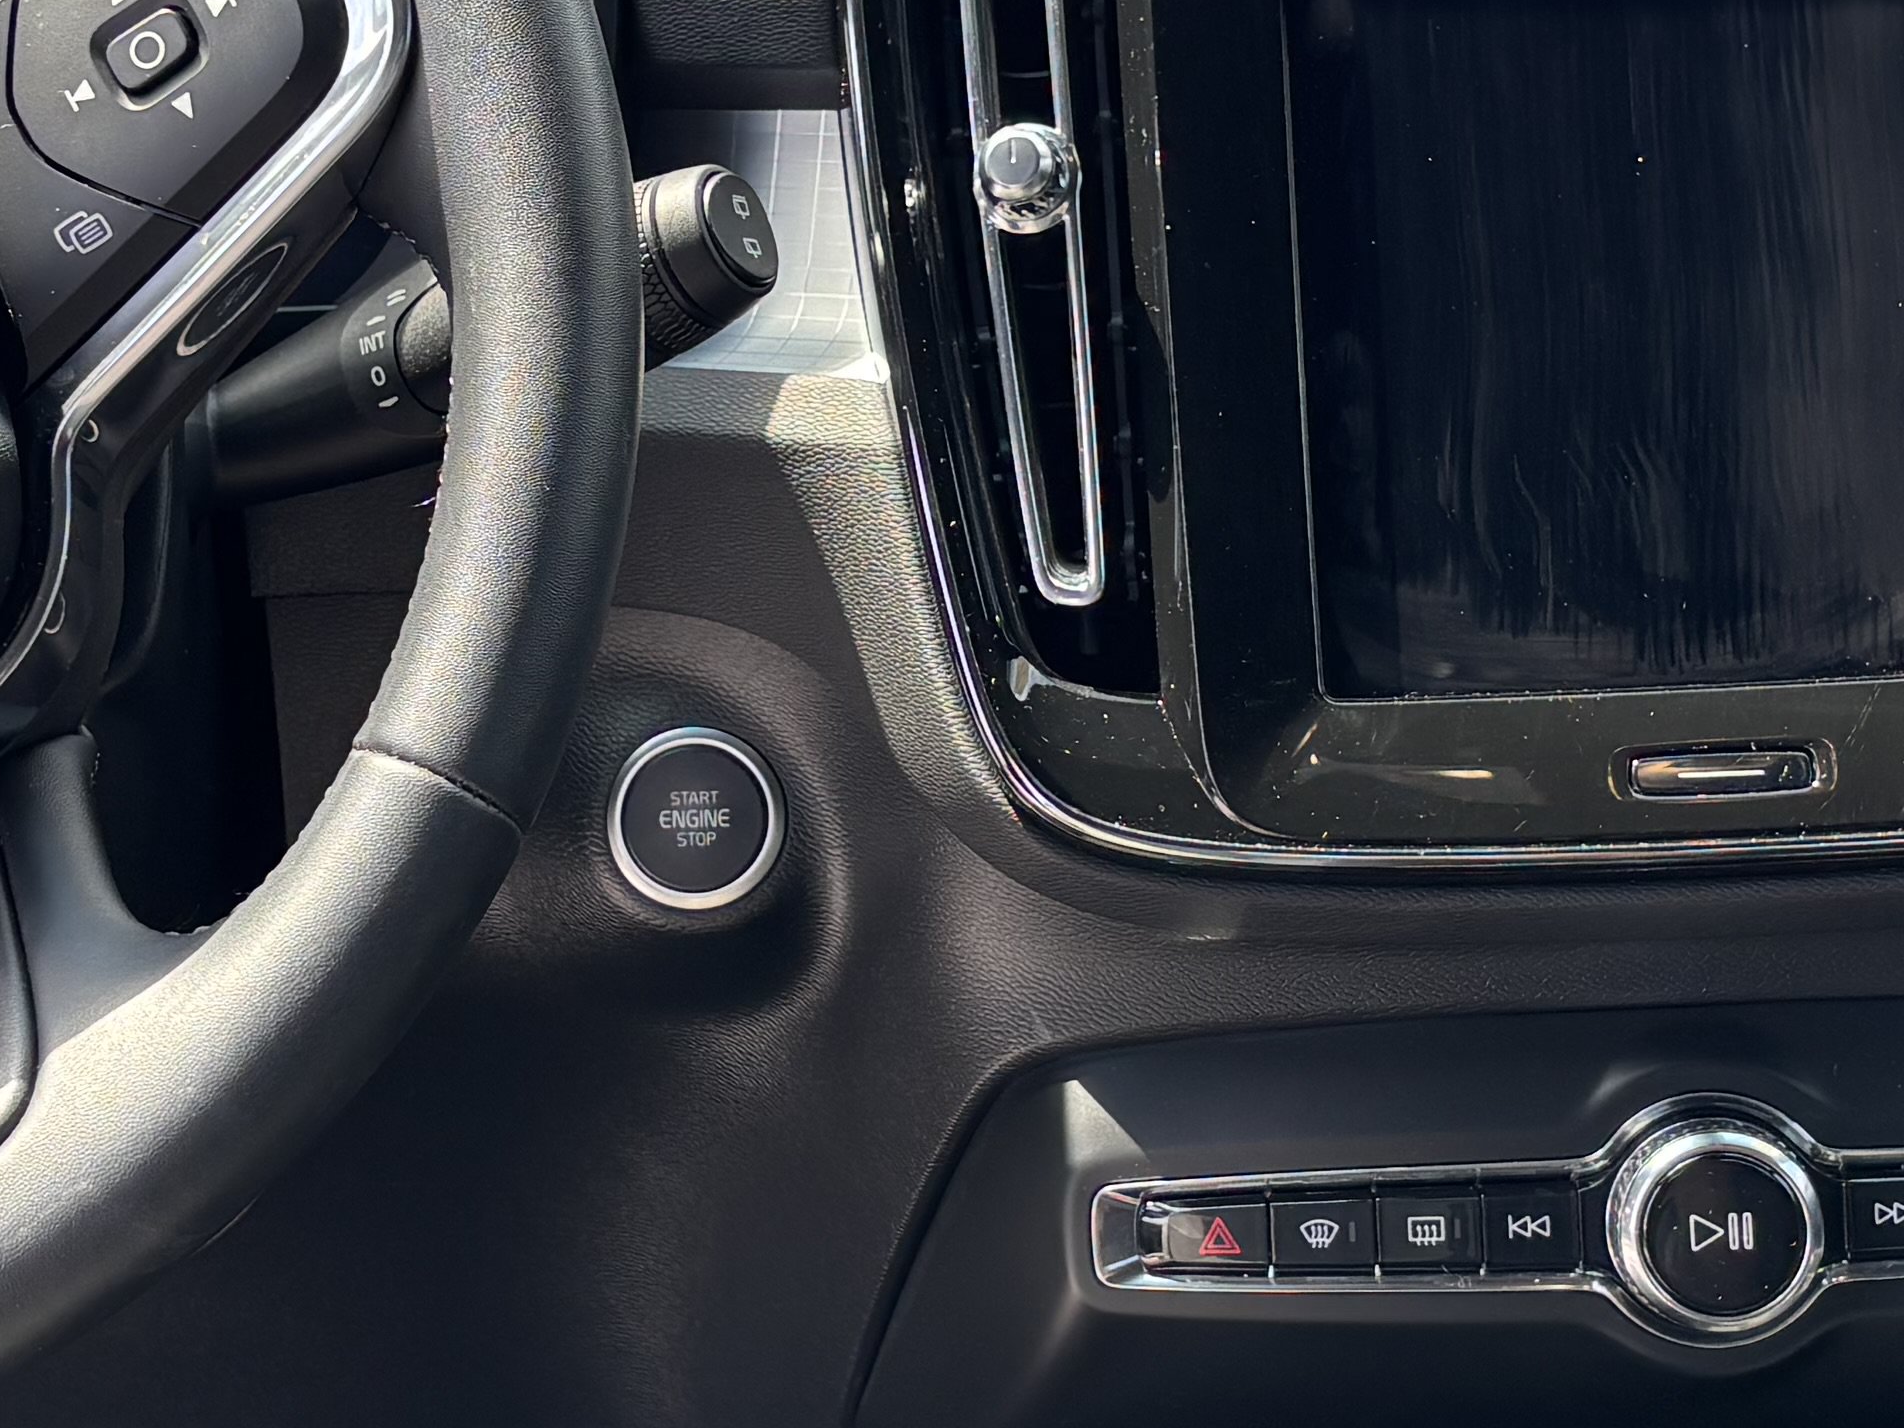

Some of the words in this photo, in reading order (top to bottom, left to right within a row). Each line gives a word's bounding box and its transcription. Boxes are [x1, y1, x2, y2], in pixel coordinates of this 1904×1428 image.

[359, 330, 386, 355] INT
[669, 790, 720, 807] START
[658, 808, 731, 829] ENGINE
[676, 831, 717, 848] STOP
